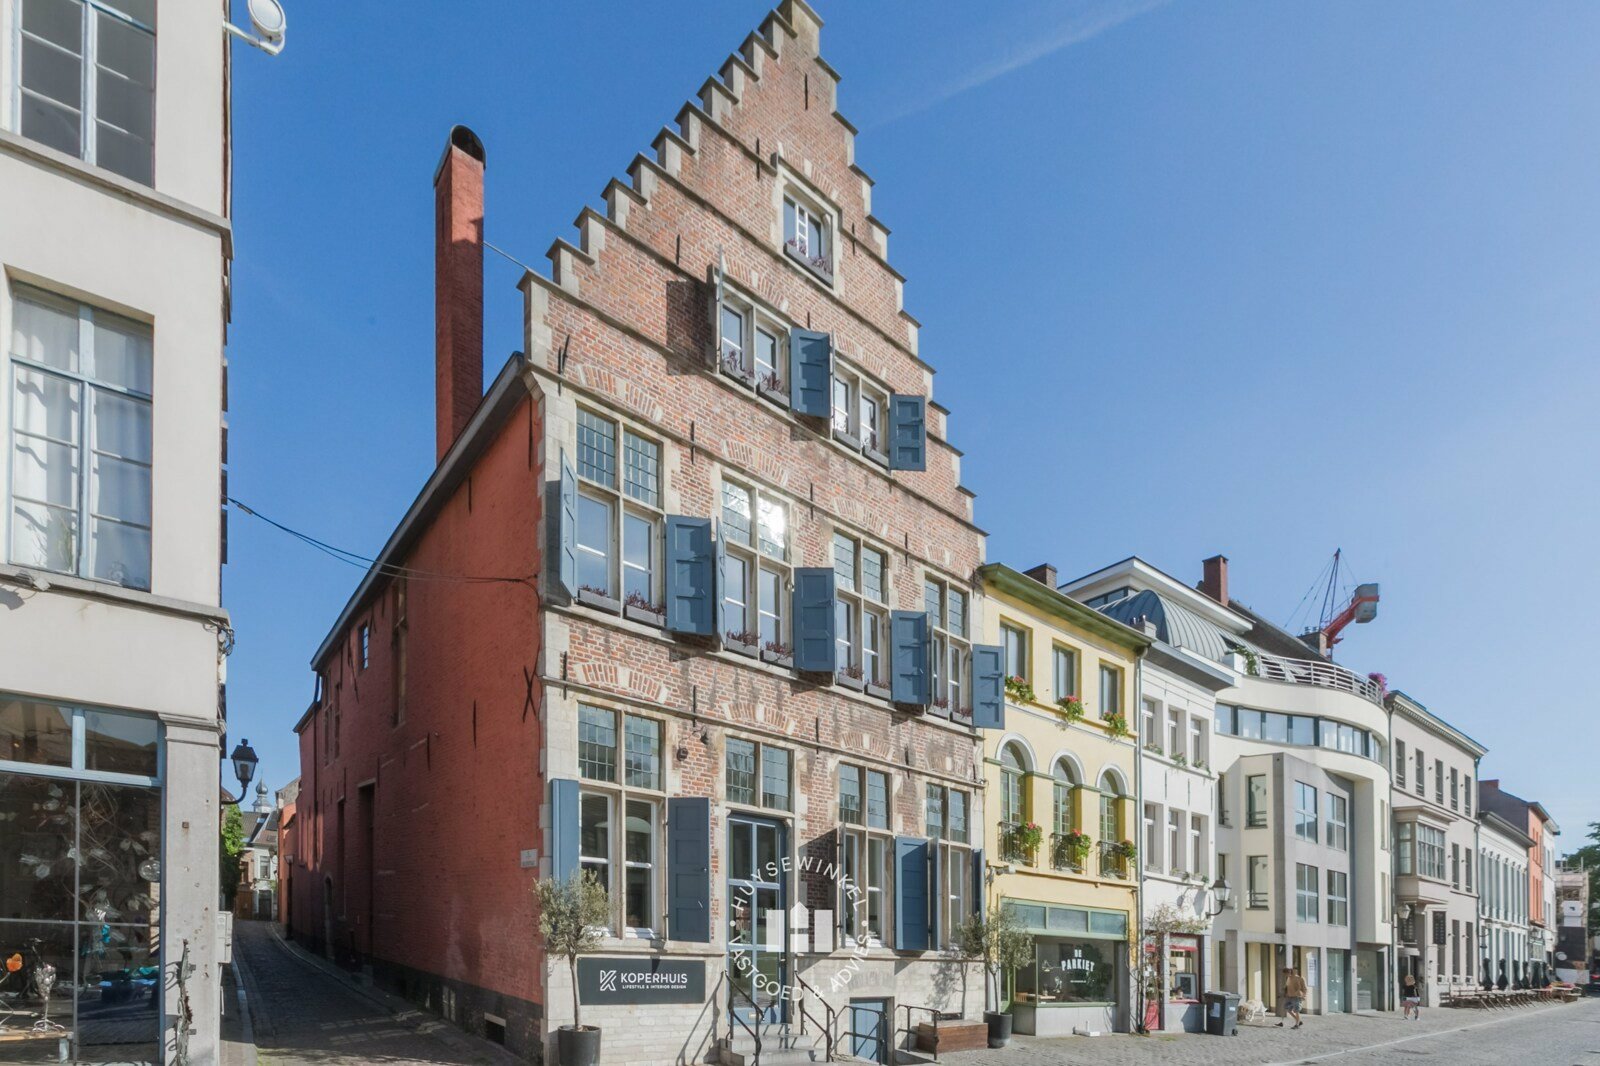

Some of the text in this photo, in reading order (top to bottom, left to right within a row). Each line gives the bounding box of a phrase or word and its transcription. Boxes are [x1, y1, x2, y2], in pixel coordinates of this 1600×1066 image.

[1074, 949, 1082, 957] DE
[1061, 958, 1095, 972] PARKIET
[620, 972, 688, 984] KOPERHUIS
